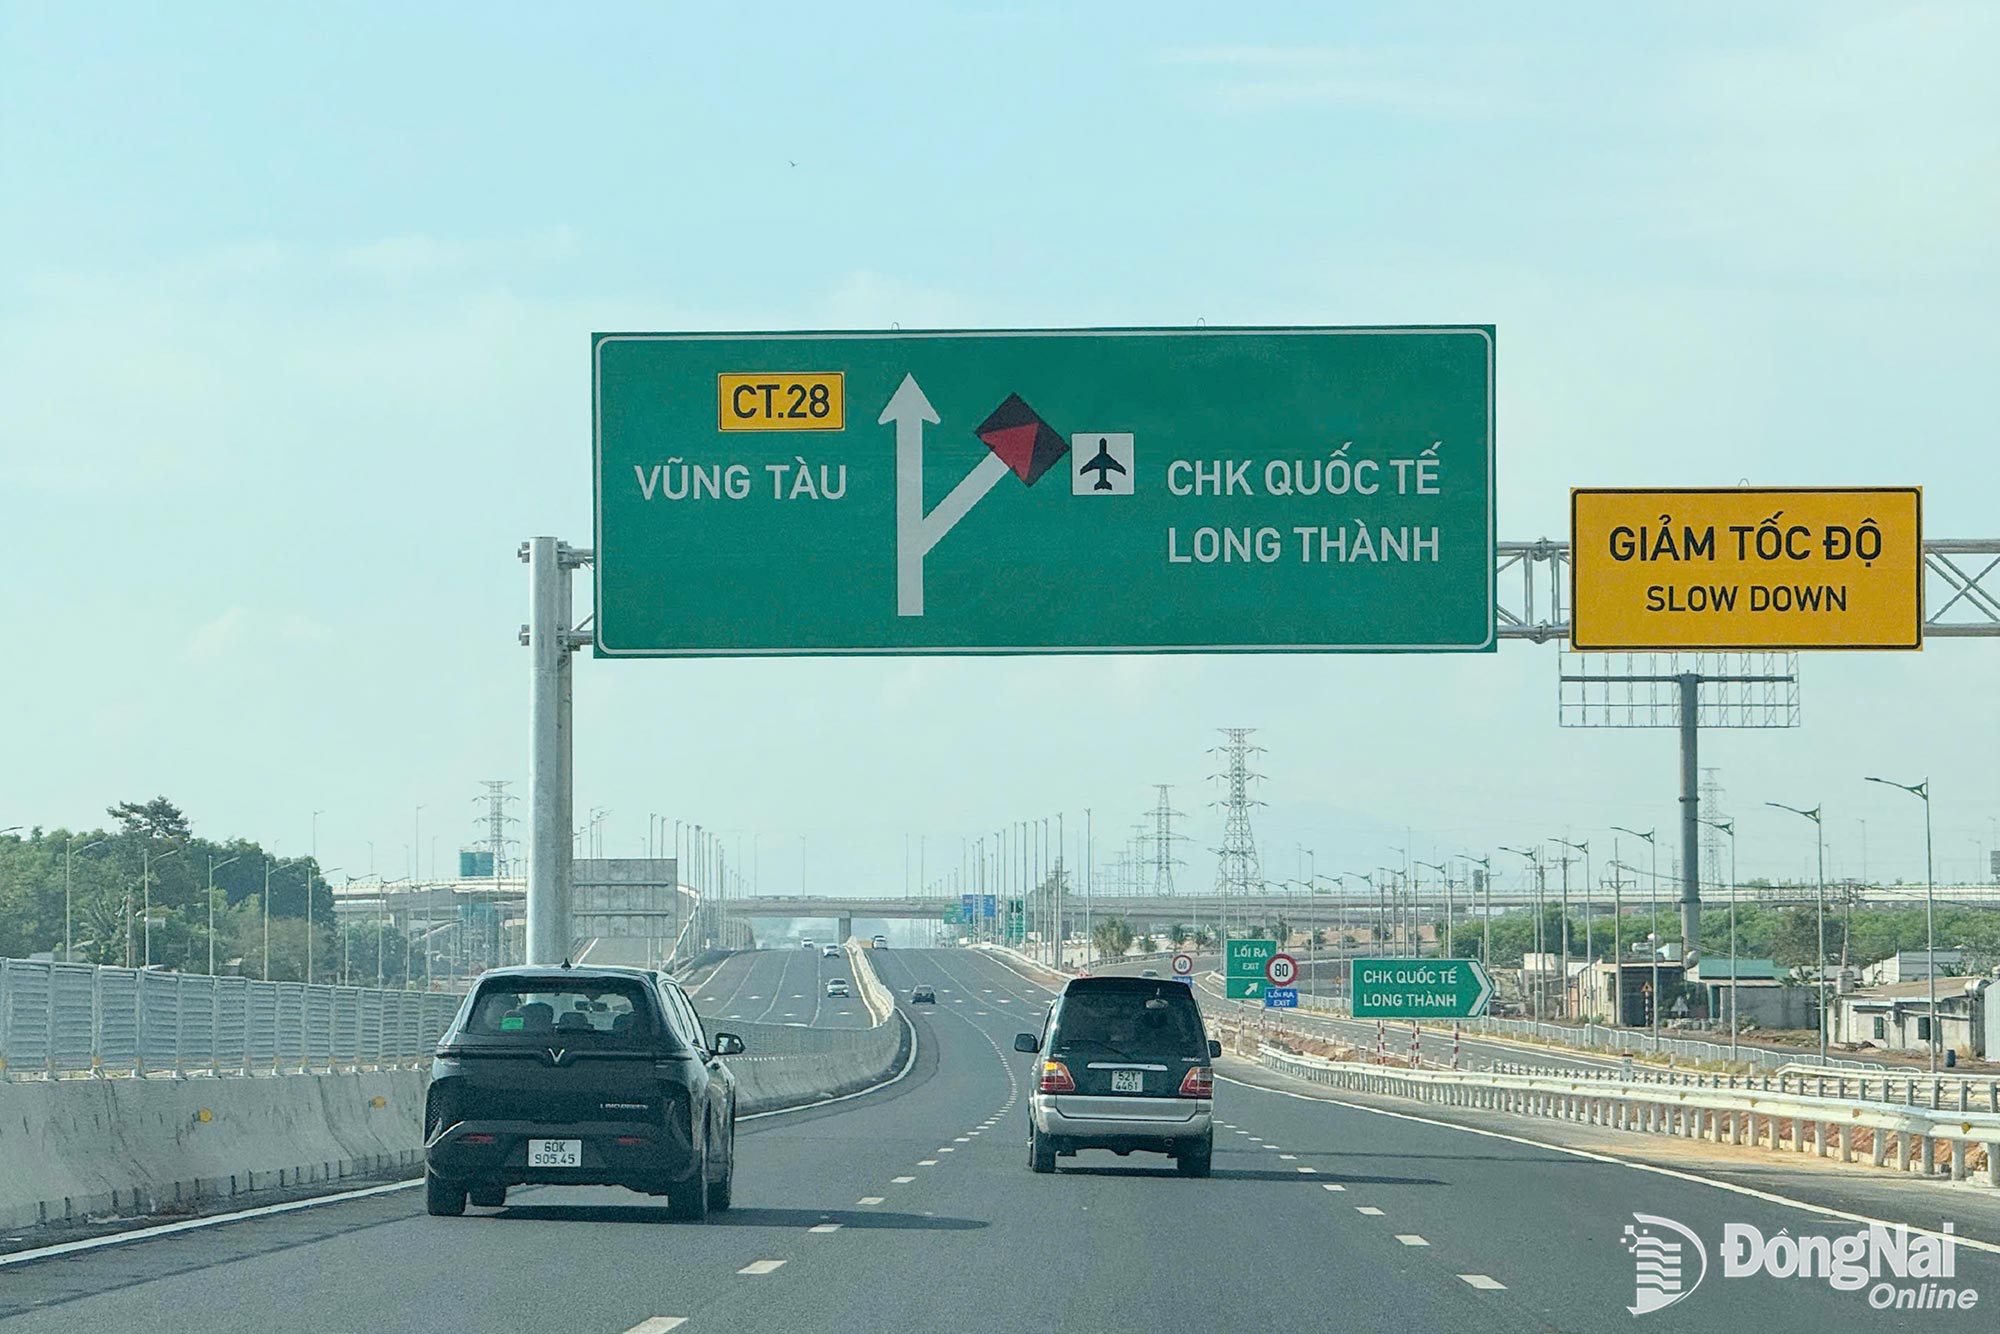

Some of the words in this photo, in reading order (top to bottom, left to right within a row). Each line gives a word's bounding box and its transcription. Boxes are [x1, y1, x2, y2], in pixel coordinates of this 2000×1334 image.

[732, 383, 831, 419] CT.28
[1167, 459, 1254, 496] CHK
[1264, 441, 1380, 496] QUỐC
[1389, 441, 1442, 495] TẾ
[634, 456, 751, 500] VŨNG
[765, 455, 847, 500] TÀU
[1168, 526, 1281, 563] LONG
[1293, 518, 1440, 563] THÀNH
[1608, 514, 1715, 562] GIẢM
[1728, 510, 1811, 561] TỐC
[1822, 517, 1882, 568] ĐỘ
[1646, 585, 1738, 612] SLOW
[1750, 585, 1847, 612] DOWN
[1234, 945, 1251, 957] LỐI
[1253, 948, 1268, 957] RA
[1178, 960, 1187, 969] 60
[1242, 962, 1260, 970] EXIT
[1274, 963, 1289, 977] 80
[1363, 970, 1393, 984] CHK
[1396, 966, 1436, 984] QUỐC
[1439, 966, 1458, 984] TẾ
[1282, 990, 1295, 998] RA
[1363, 993, 1403, 1007] LONG
[1406, 990, 1457, 1007] THÀNH
[544, 1141, 565, 1152] 60K
[534, 1153, 575, 1165] 905.45
